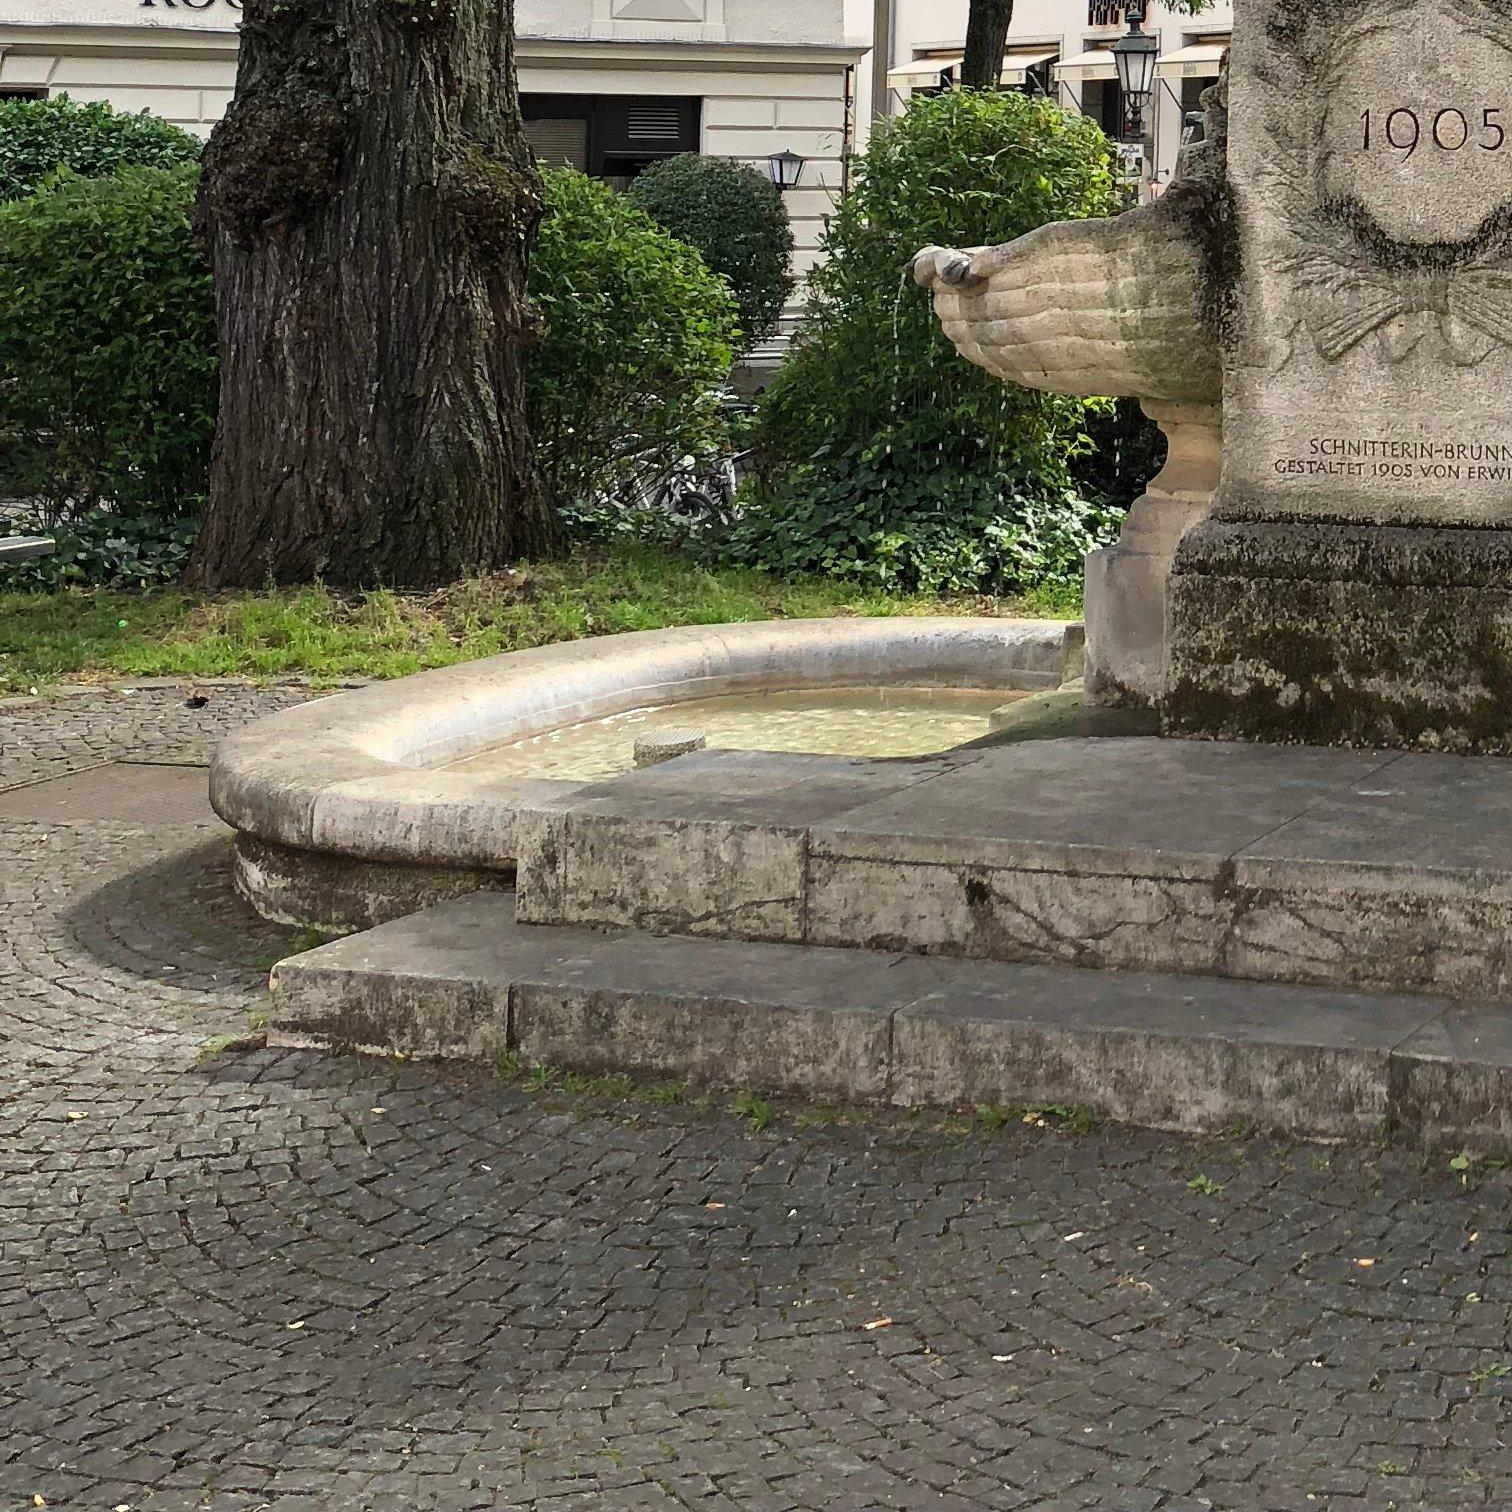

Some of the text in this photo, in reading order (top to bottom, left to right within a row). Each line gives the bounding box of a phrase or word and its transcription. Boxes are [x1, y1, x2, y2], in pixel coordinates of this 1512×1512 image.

[1360, 107, 1505, 164] 1905
[1274, 459, 1365, 476] GESTALTET
[1371, 464, 1413, 478] 1905
[1421, 464, 1461, 480] VON
